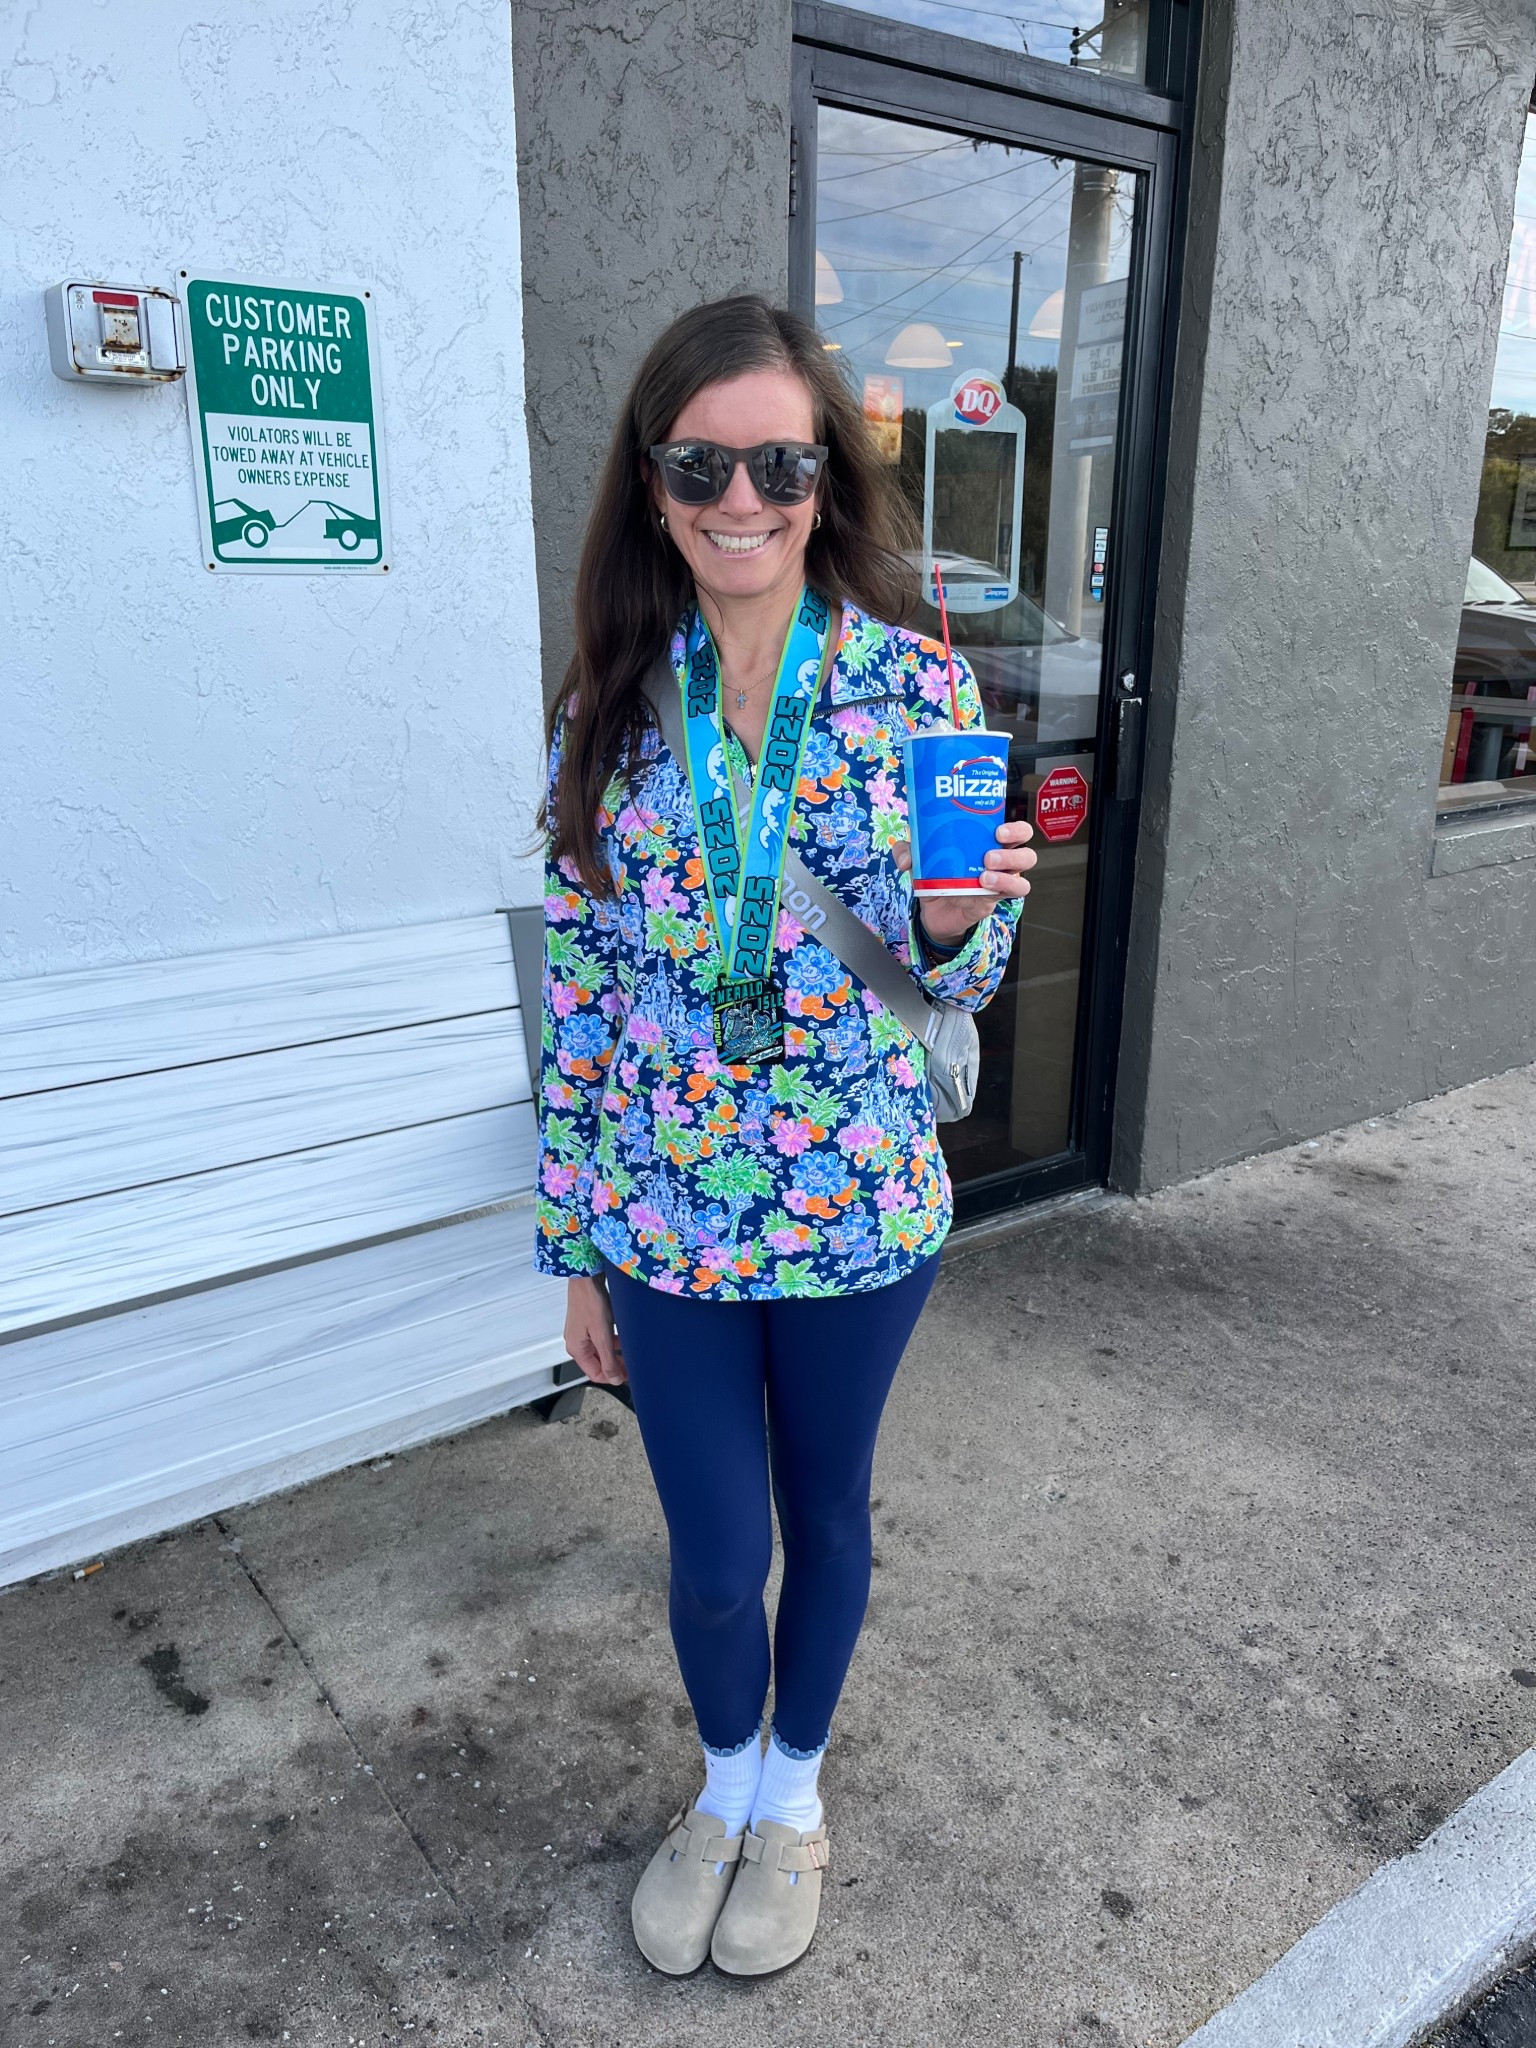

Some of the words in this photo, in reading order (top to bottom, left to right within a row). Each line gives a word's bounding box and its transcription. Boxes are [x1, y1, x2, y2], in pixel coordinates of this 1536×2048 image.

[205, 292, 352, 339] CUSTOMER
[223, 332, 343, 375] PARKING
[251, 374, 321, 410] ONLY
[961, 388, 995, 417] DQ
[227, 425, 300, 444] VIOLATORS
[302, 429, 334, 447] WILL
[336, 432, 353, 448] BE
[212, 446, 257, 464] TOWED
[260, 448, 296, 466] AWAY
[298, 450, 315, 467] AT
[318, 452, 370, 469] VEHICLE
[237, 468, 291, 486] OWNERS
[294, 471, 351, 488] EXPENSE
[687, 642, 717, 719] 2025
[761, 695, 808, 792] 2025
[935, 774, 1007, 798] Blizzar
[981, 769, 999, 777] Original
[1049, 776, 1078, 787] WARNING
[1041, 795, 1069, 811] DTT
[701, 797, 741, 899] 2025
[734, 875, 775, 978] 2025
[708, 980, 764, 1006] EMERALD
[757, 991, 785, 1011] ISLE
[713, 1013, 723, 1047] 2025
